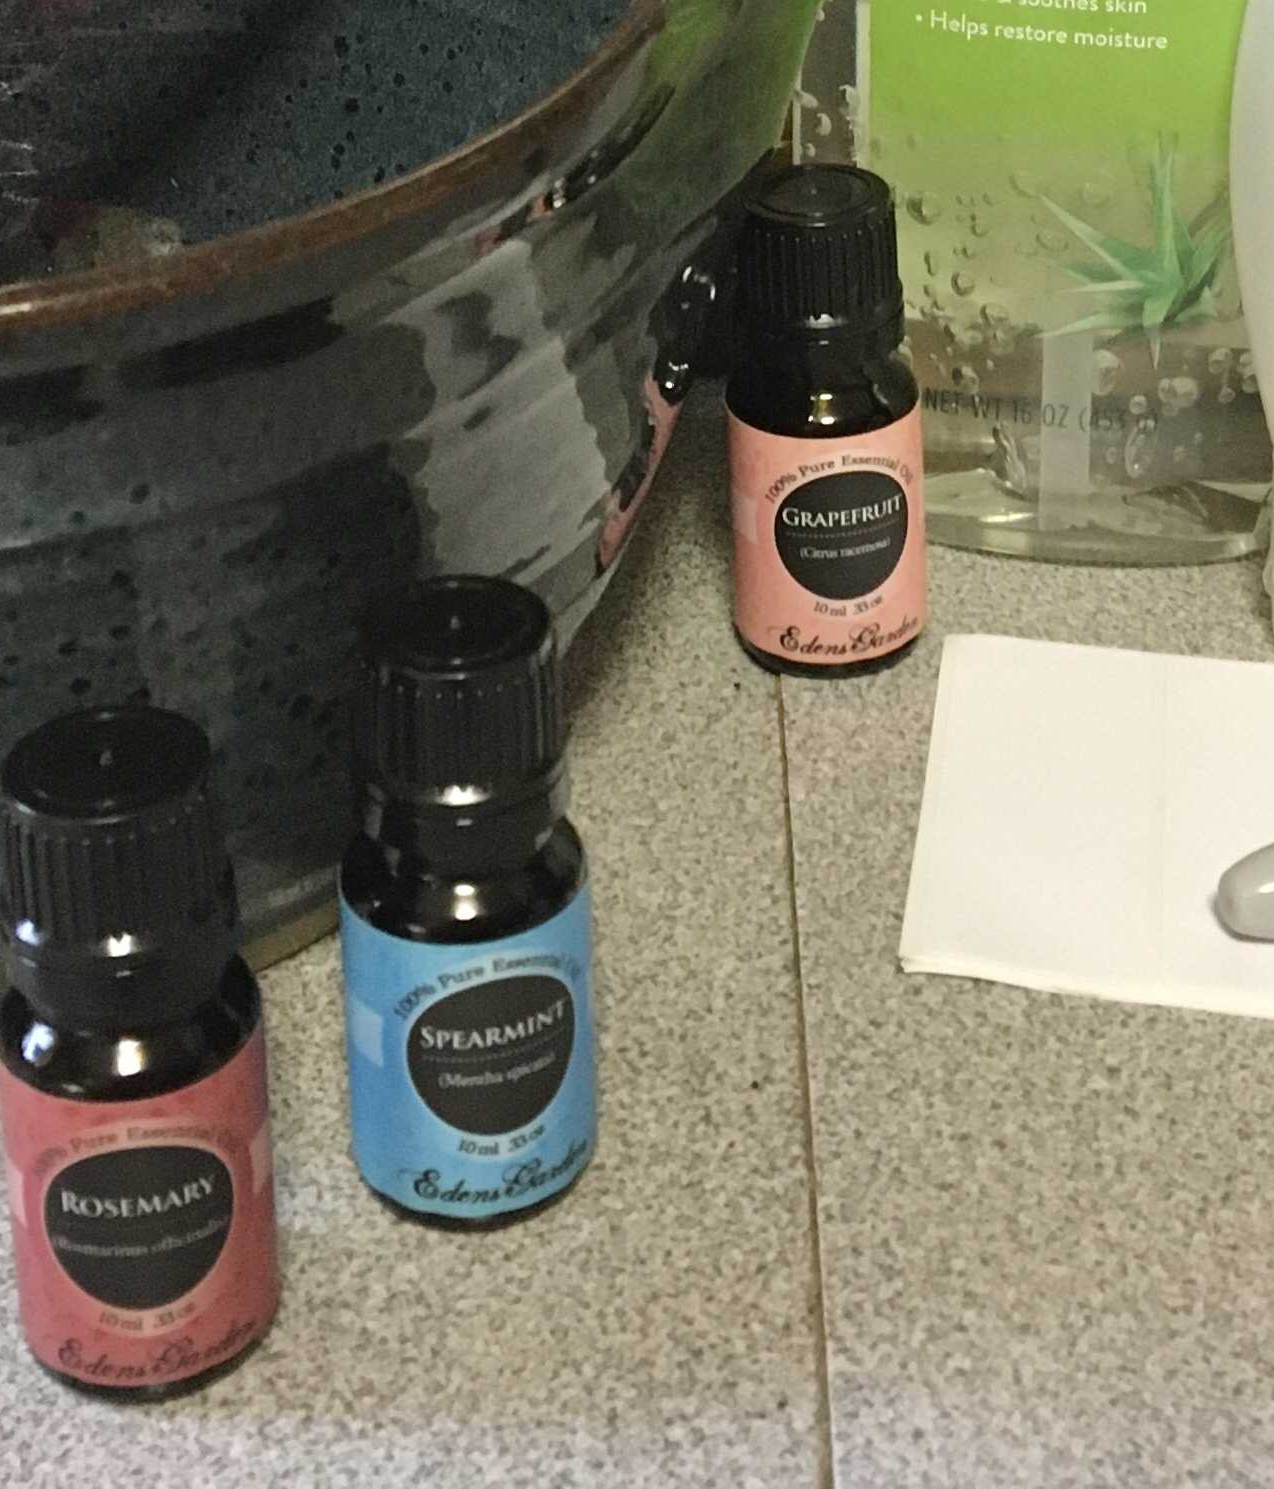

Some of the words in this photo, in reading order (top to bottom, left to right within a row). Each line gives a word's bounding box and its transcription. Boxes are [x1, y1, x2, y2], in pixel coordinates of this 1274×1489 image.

[930, 10, 988, 40] Helps
[994, 19, 1067, 44] restore
[1074, 27, 1168, 50] moisture
[798, 460, 835, 477] Pure
[781, 492, 903, 528] GRAPEFRUIT
[420, 998, 566, 1050] SPEARMINT
[61, 1174, 215, 1218] ROSEMARY
